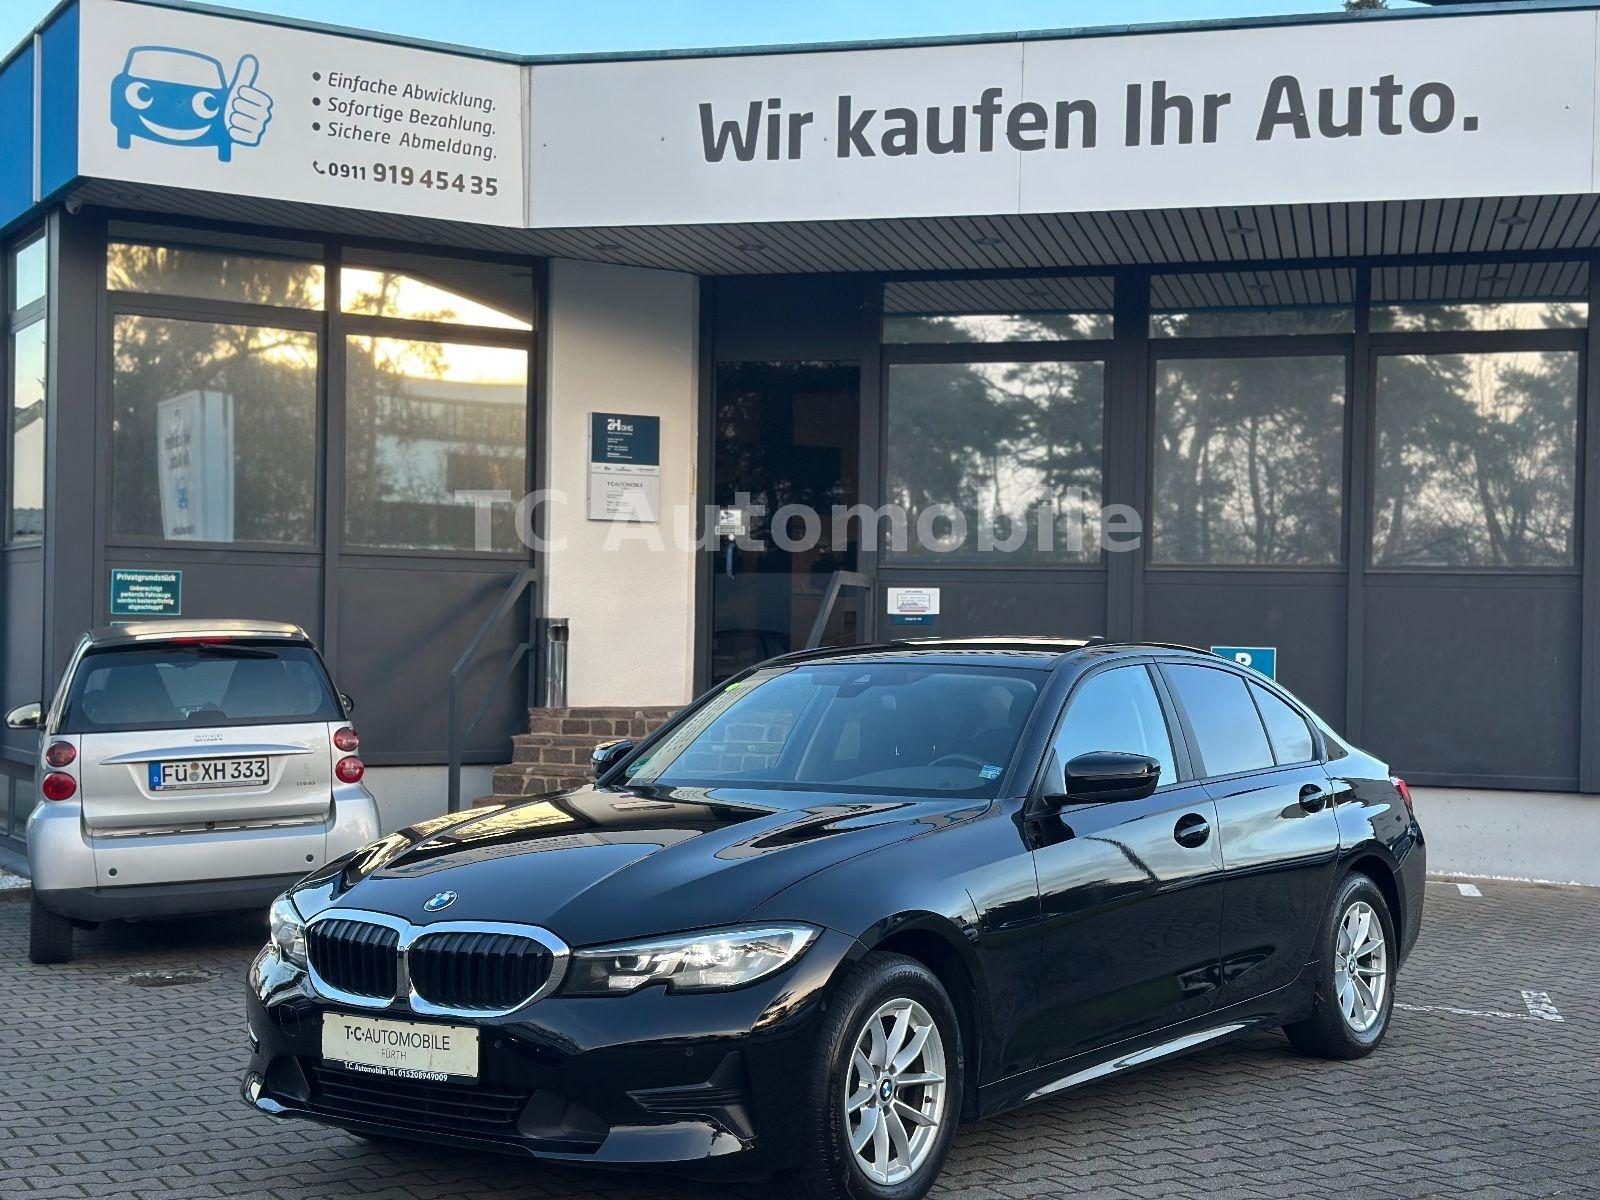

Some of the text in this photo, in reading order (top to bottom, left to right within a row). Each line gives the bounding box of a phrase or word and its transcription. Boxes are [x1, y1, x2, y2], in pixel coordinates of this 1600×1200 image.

[328, 71, 496, 113] Einfache Abwicklung.
[328, 97, 496, 137] Sofortige Bezahlung.
[699, 74, 1479, 163] Wir kaufen Ihr Auto.
[328, 121, 497, 161] Sichere Abmeldung.
[328, 162, 498, 197] 0911 919 454 35
[116, 573, 176, 582] Privatgrundstück
[162, 764, 187, 783] FÜ
[201, 763, 226, 781] XH
[230, 760, 265, 779] 333
[355, 1063, 387, 1075] Automobile
[381, 1047, 407, 1060] FÜRTH
